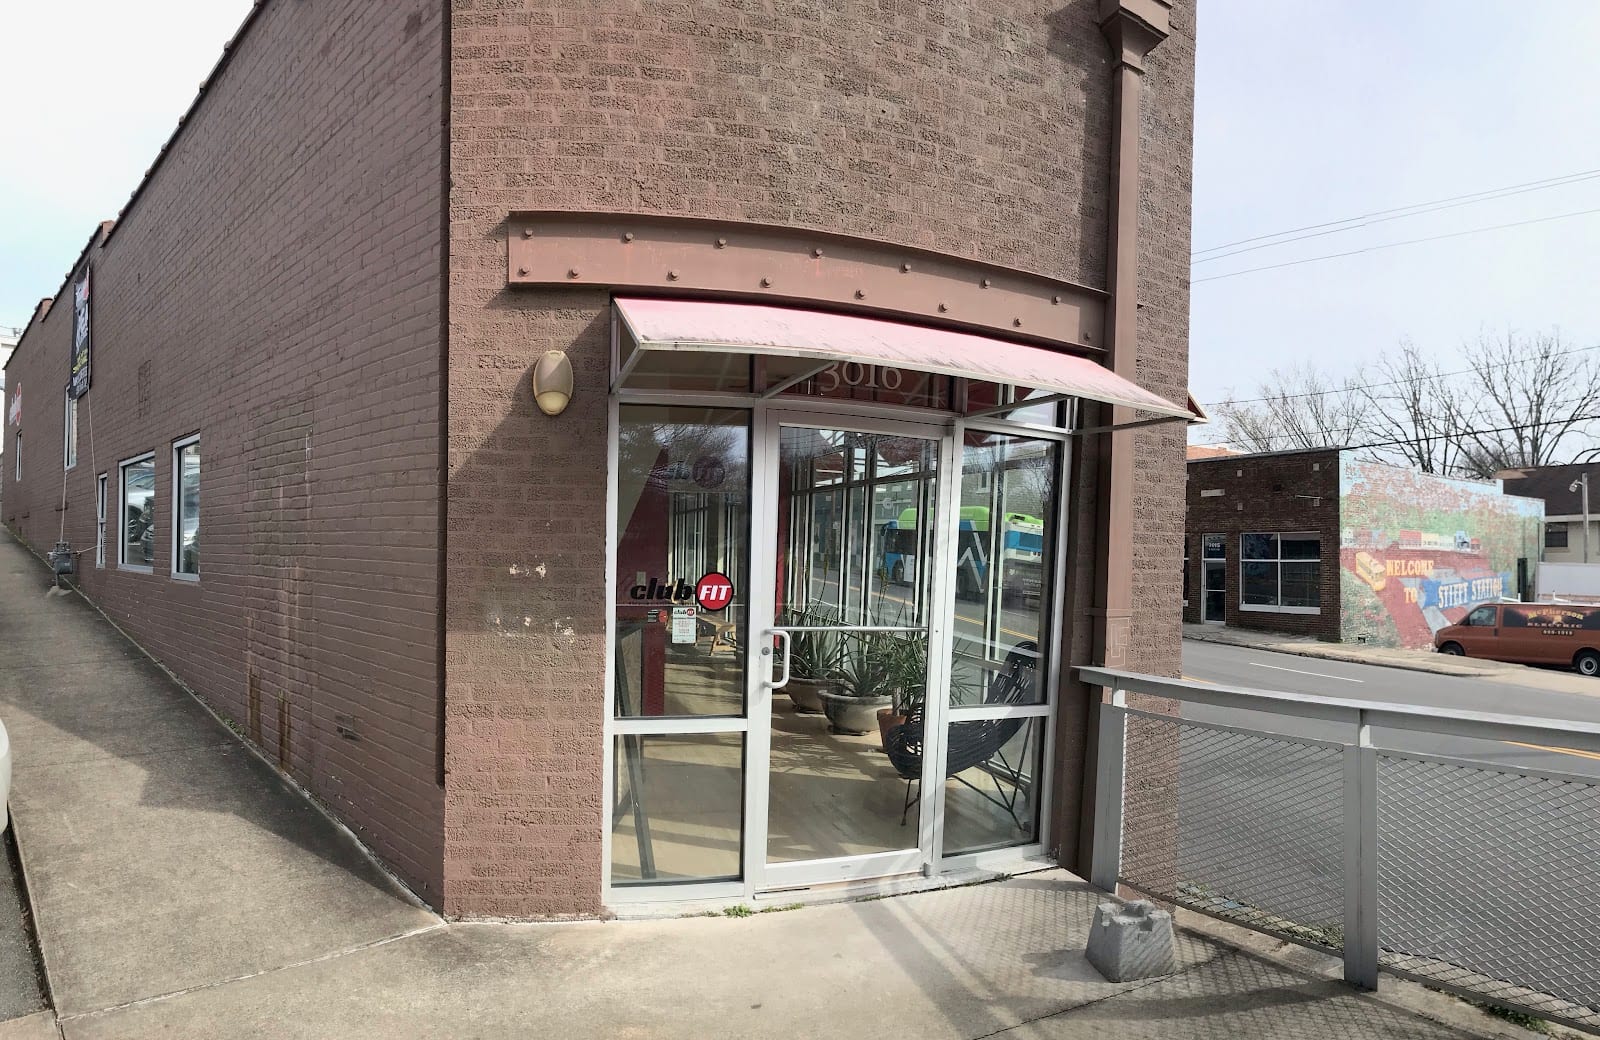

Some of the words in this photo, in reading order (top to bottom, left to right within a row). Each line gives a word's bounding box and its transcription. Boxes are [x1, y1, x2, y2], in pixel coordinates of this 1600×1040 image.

[820, 361, 901, 392] 3016
[1386, 560, 1434, 576] WELCOME
[630, 578, 693, 600] club
[699, 585, 731, 600] FIT
[1404, 588, 1417, 603] TO
[1471, 577, 1503, 600] STATION
